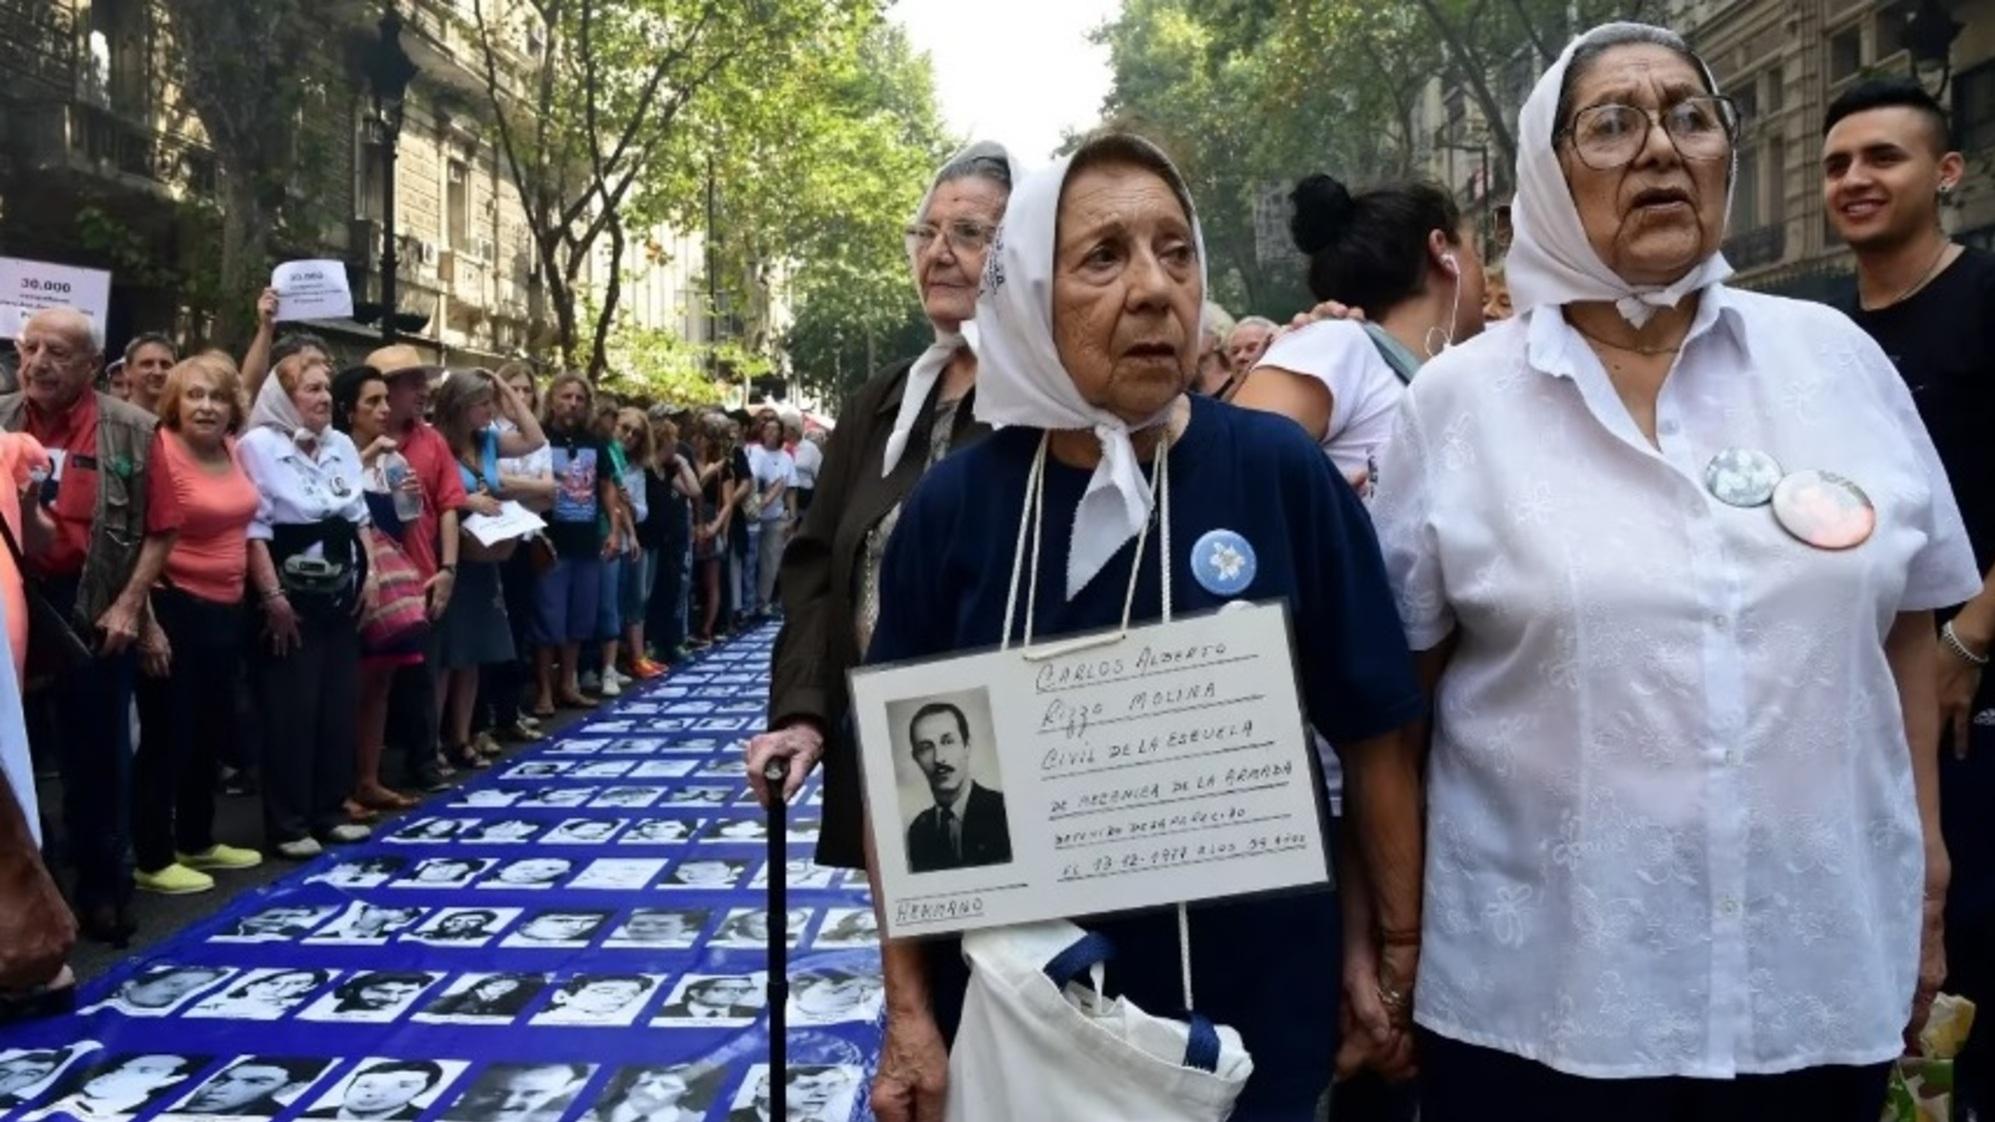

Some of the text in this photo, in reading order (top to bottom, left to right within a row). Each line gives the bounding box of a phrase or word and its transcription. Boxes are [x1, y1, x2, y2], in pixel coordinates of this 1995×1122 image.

[21, 278, 71, 293] 30.000
[1036, 644, 1226, 693] CARLOS ALBERTO
[1129, 682, 1215, 710] MOLINA
[1109, 744, 1131, 759] DE
[1138, 737, 1159, 755] LA
[1171, 780, 1189, 794] DE
[1196, 777, 1216, 790] LA
[1225, 760, 1294, 785] ARMADA
